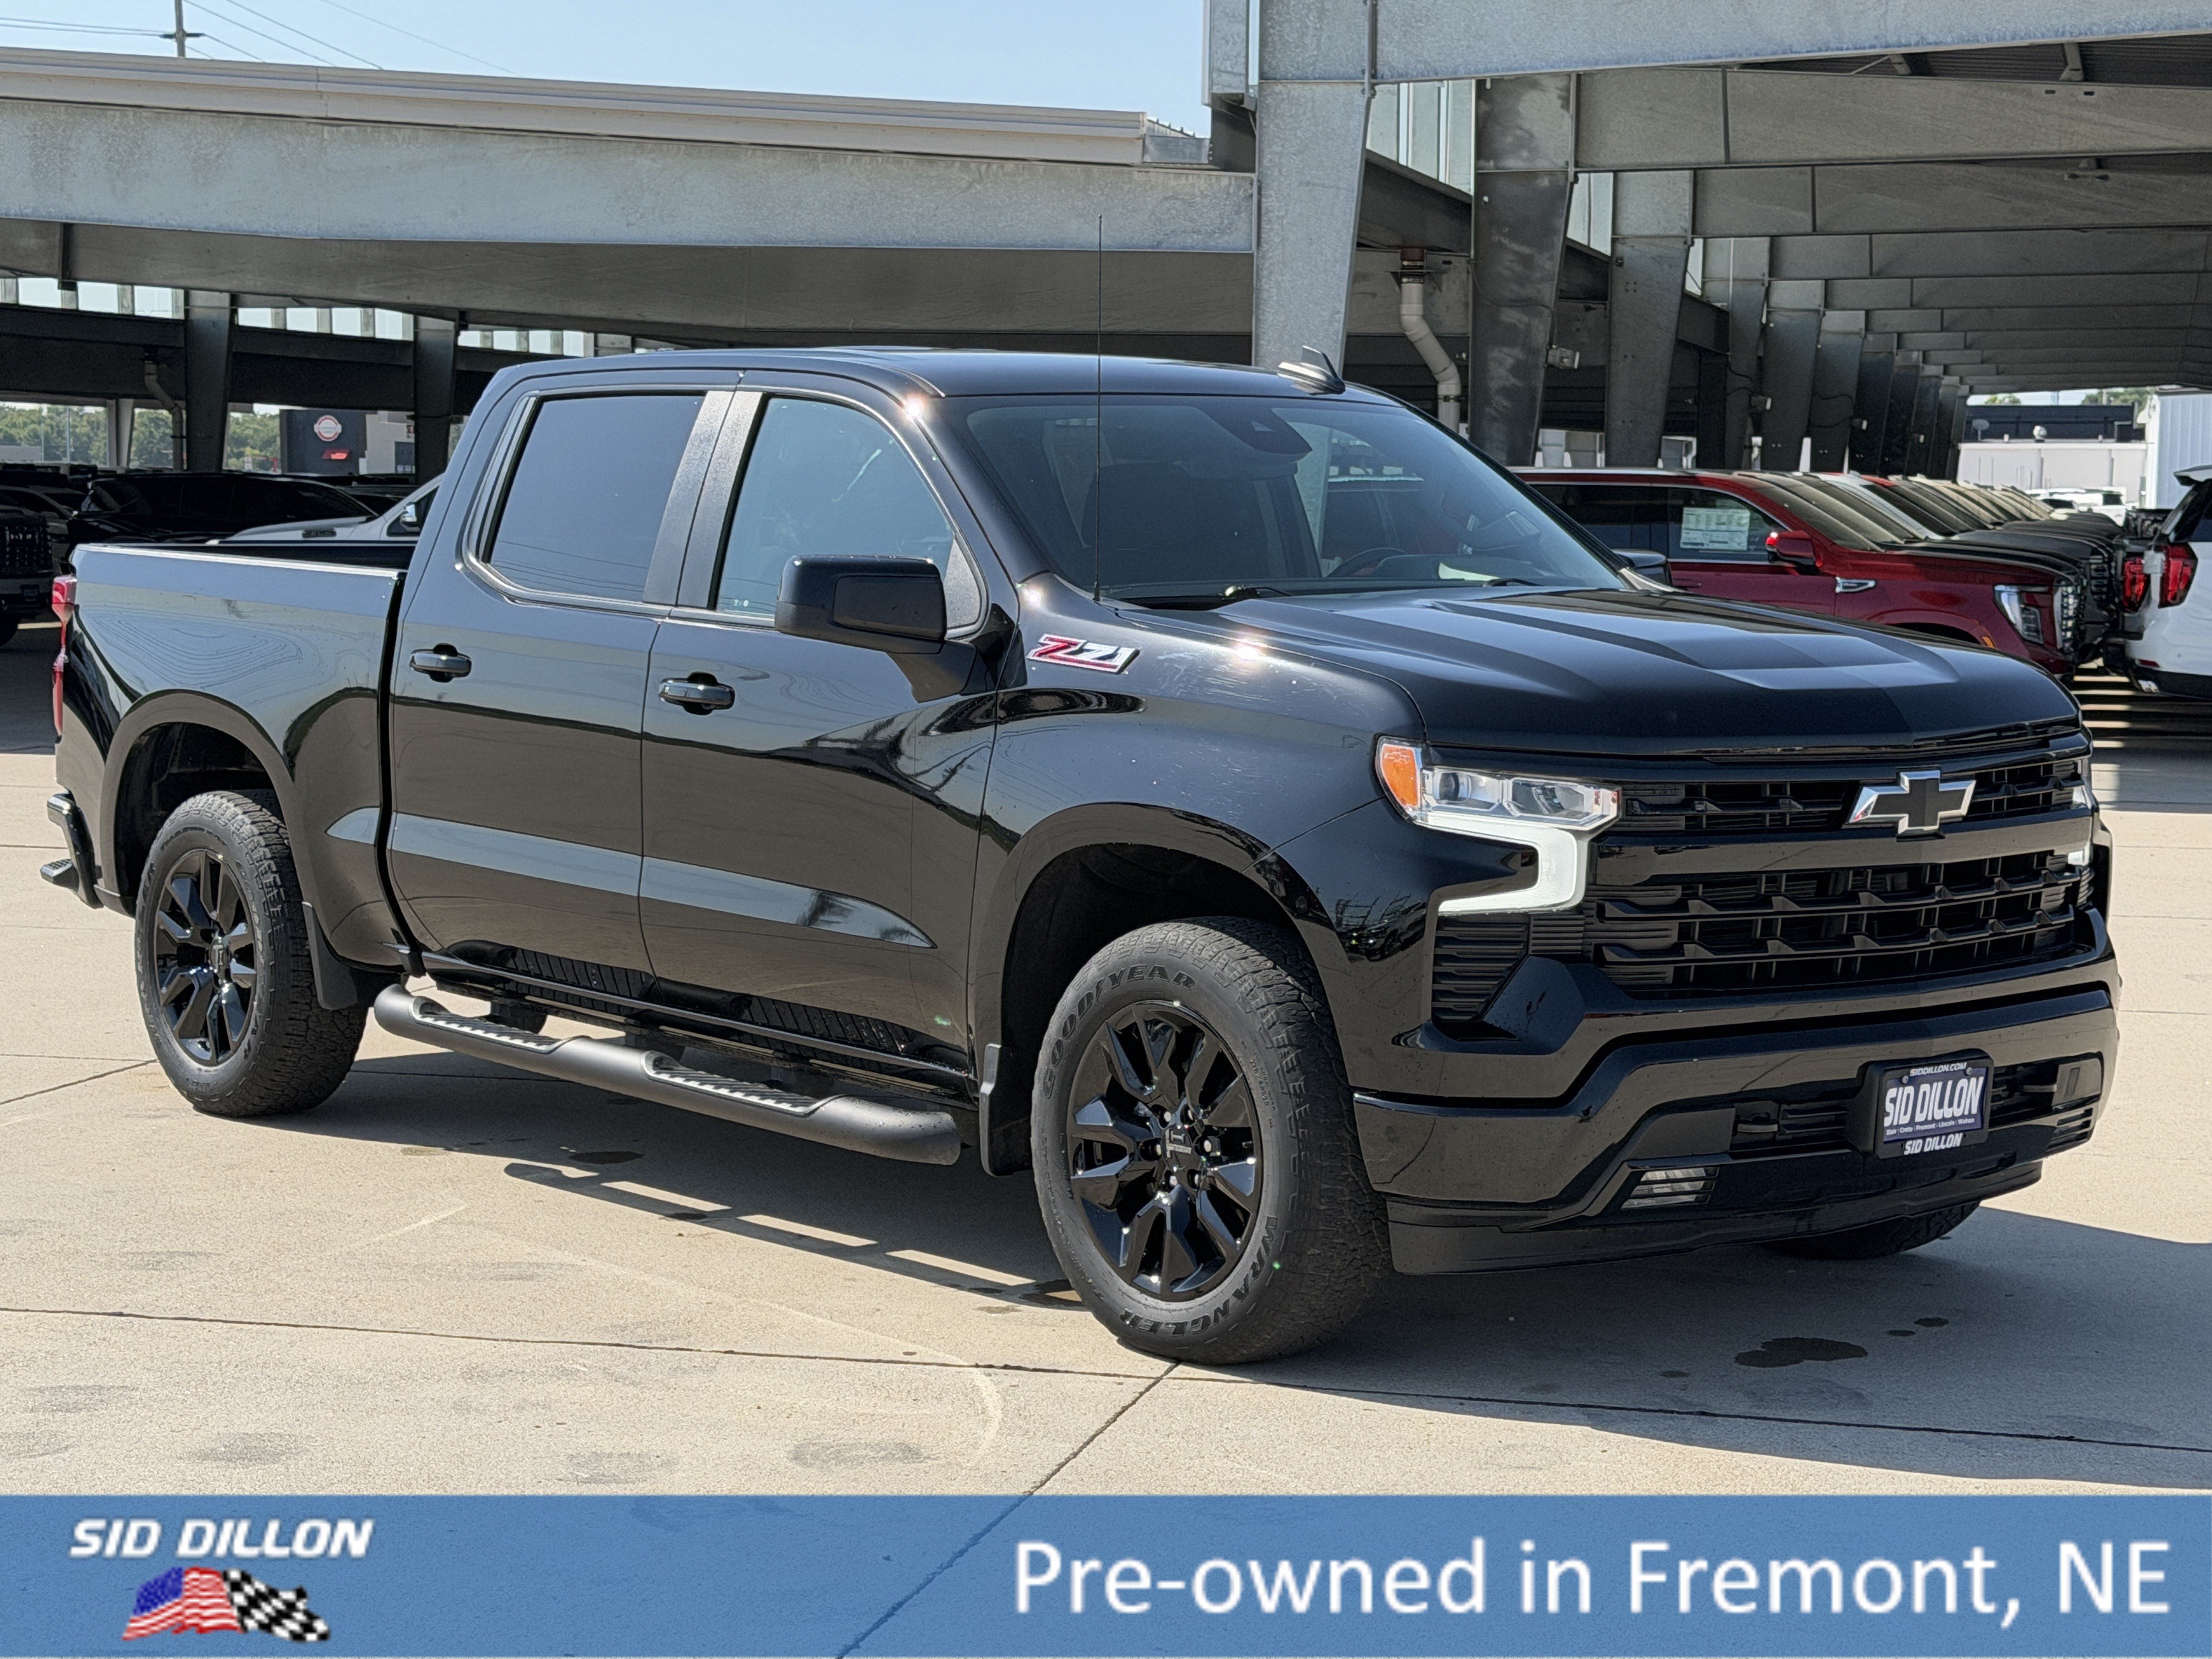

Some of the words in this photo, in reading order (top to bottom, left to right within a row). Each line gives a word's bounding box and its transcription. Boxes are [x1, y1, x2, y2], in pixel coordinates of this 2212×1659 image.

[1026, 633, 1138, 673] Z71
[1043, 964, 1194, 1099] GOODYEAR
[1910, 1062, 1967, 1076] SIDDILLON.COM
[1883, 1086, 1915, 1127] SID
[1915, 1076, 1984, 1122] DILLON
[1904, 1139, 1922, 1155] SID
[1923, 1132, 1963, 1152] DILLON
[1120, 1216, 1279, 1336] WRANGLER
